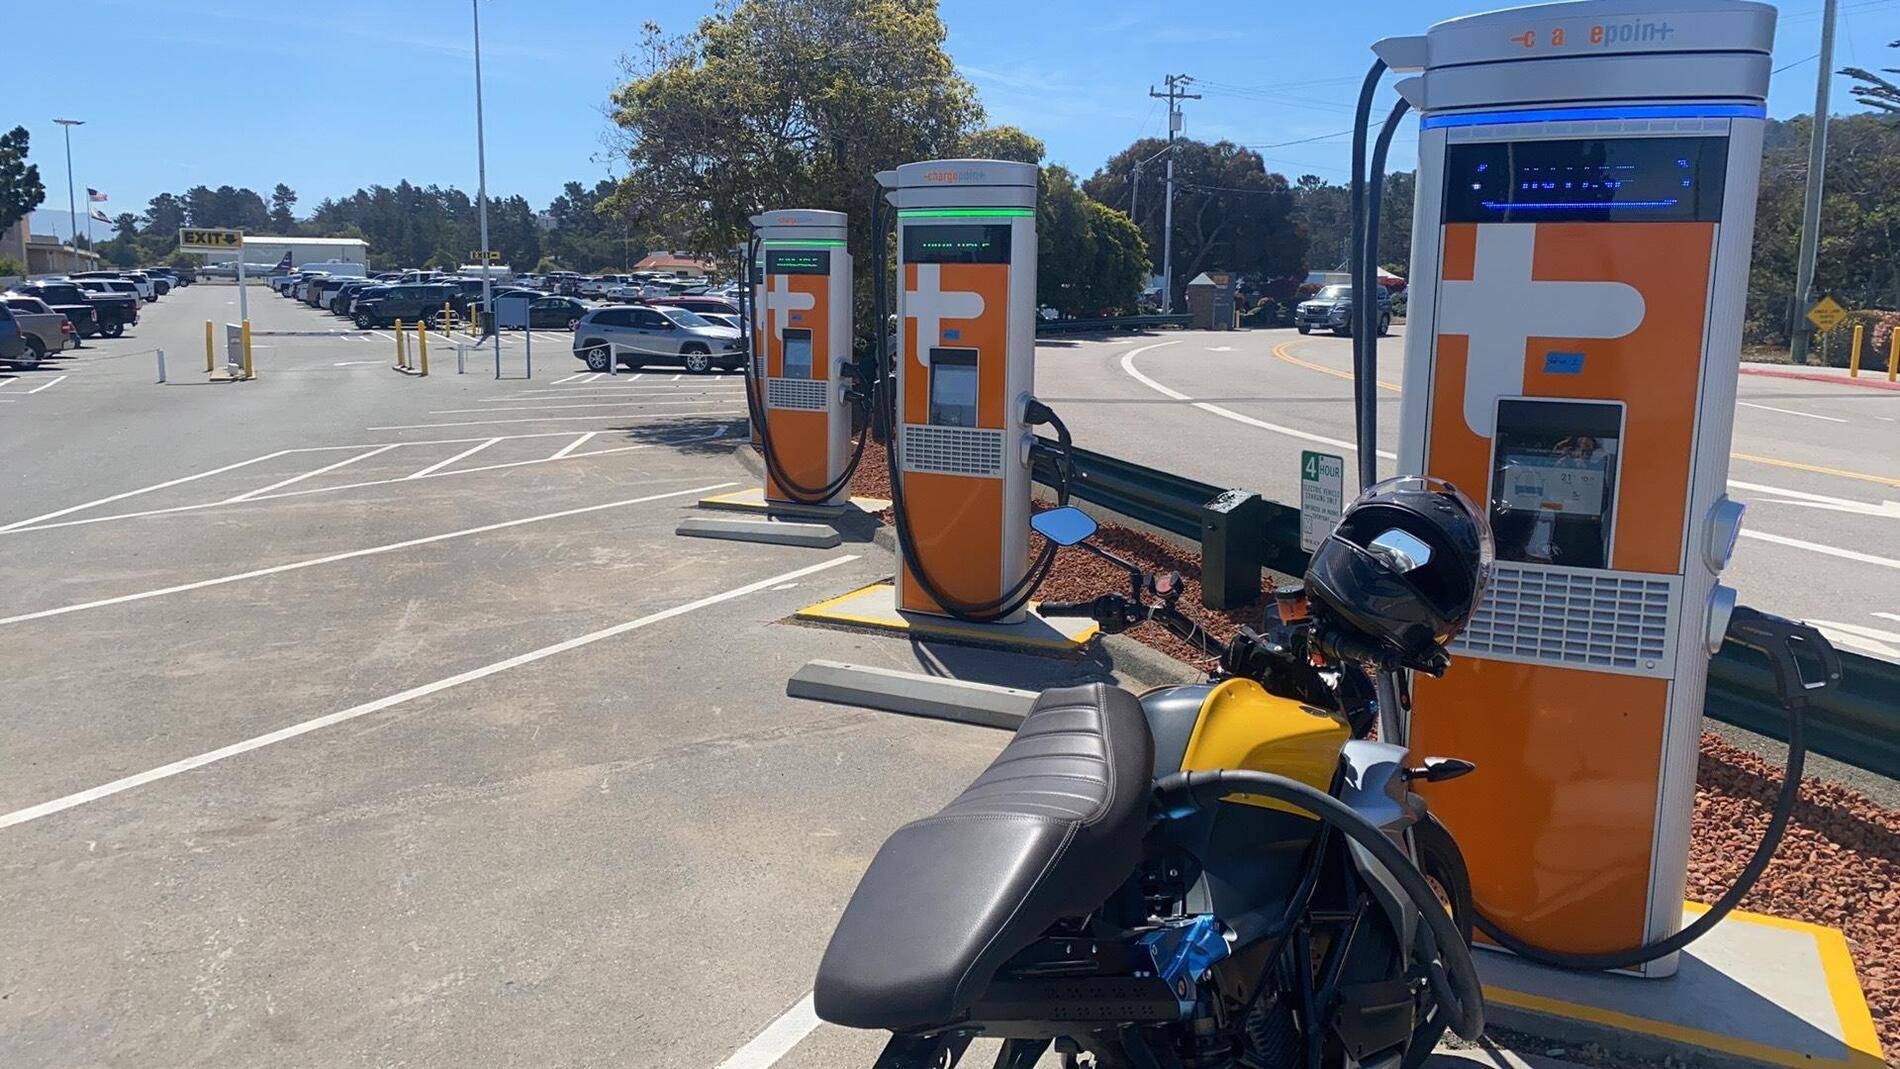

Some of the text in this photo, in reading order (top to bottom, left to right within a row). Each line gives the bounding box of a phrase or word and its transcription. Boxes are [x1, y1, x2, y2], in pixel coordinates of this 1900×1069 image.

[184, 231, 222, 244] EXIT
[1305, 457, 1340, 478] 4 HOUR
